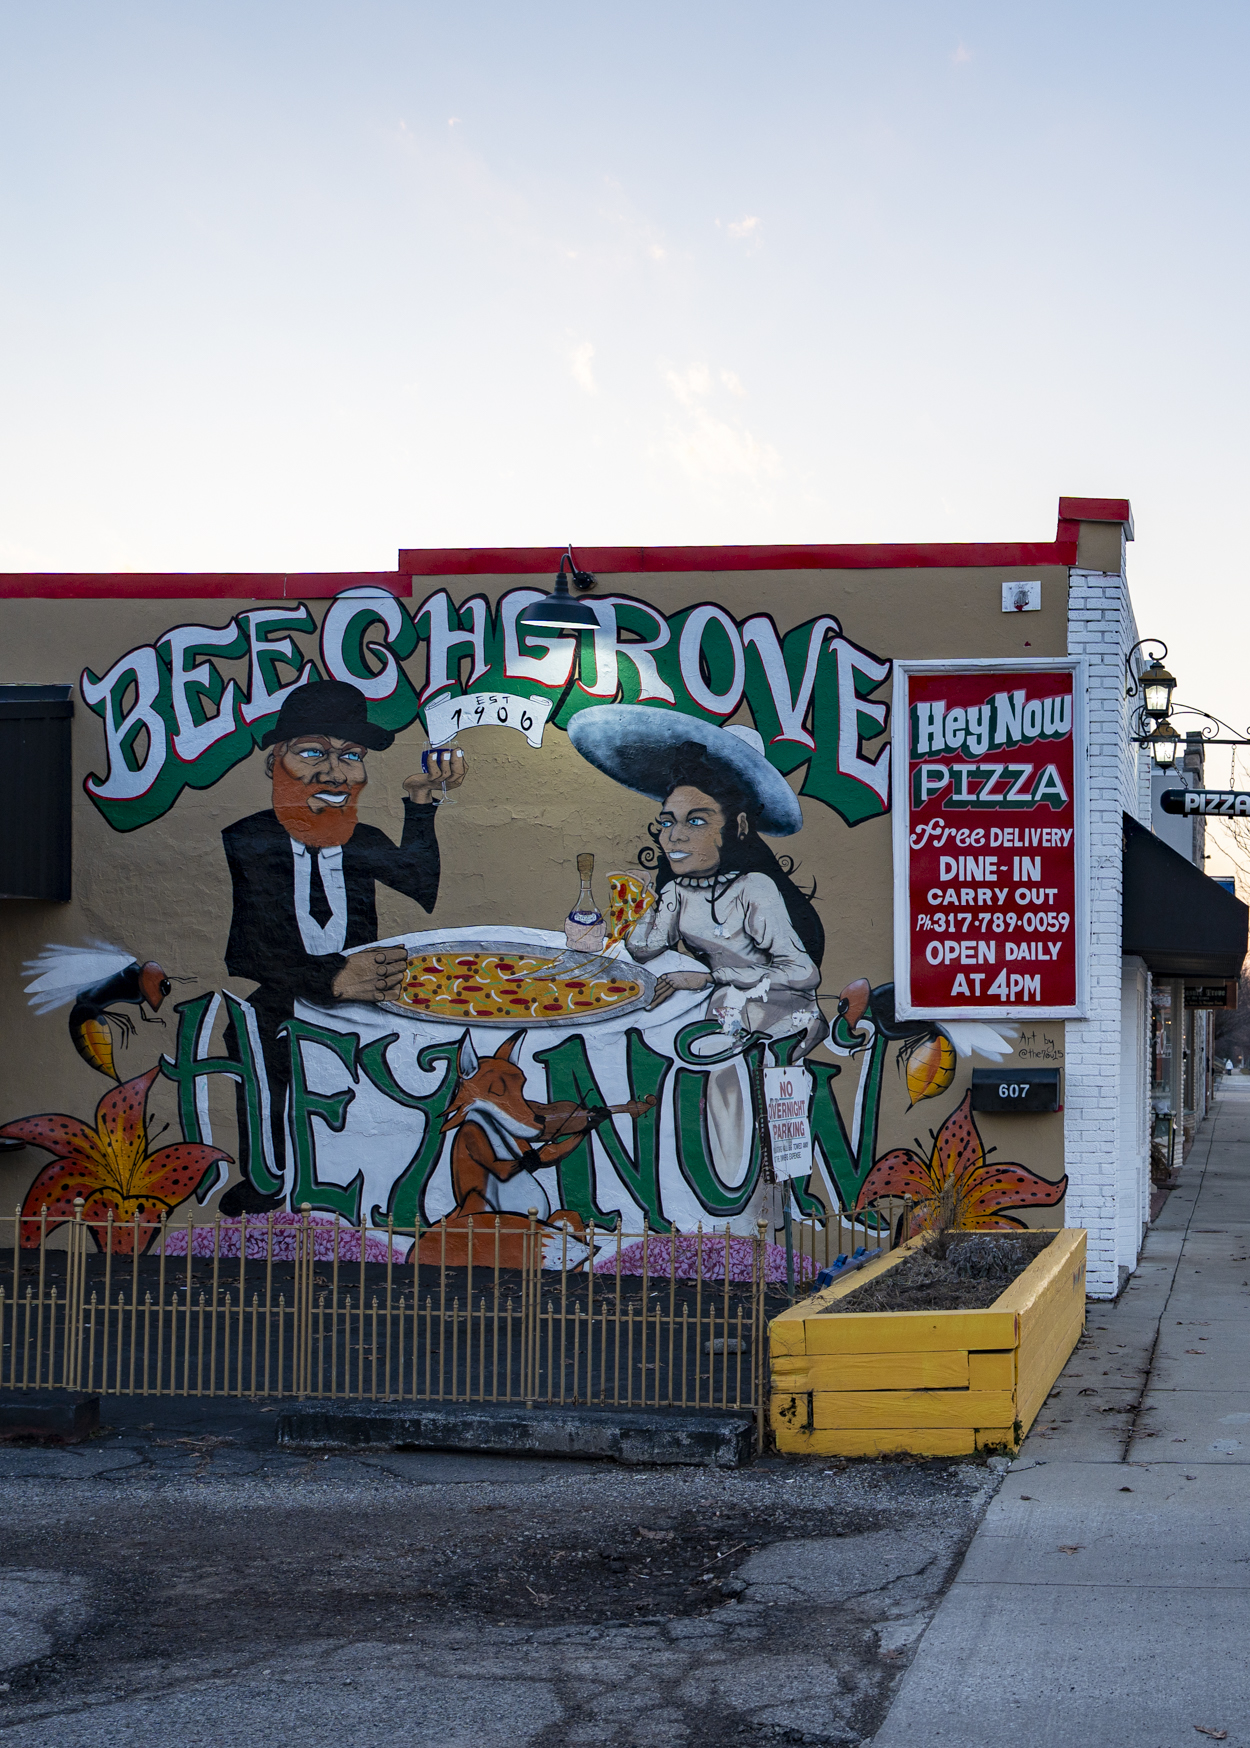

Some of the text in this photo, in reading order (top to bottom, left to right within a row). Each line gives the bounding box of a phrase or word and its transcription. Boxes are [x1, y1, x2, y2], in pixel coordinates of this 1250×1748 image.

[475, 695, 511, 706] EST
[450, 706, 533, 731] 1906
[915, 688, 1073, 757] Hey Now
[919, 764, 1069, 803] PIZZA
[989, 827, 1074, 847] DELIVERY
[926, 887, 1058, 906] CARRY OUT
[925, 940, 1063, 966] OPEN DAILY
[950, 967, 1041, 1002] AT 4PM
[1019, 1030, 1055, 1053] Art by
[779, 1080, 794, 1098] NO
[998, 1083, 1030, 1098] 607
[768, 1099, 806, 1121] OVERNIGHT
[772, 1120, 806, 1141] PARKING
